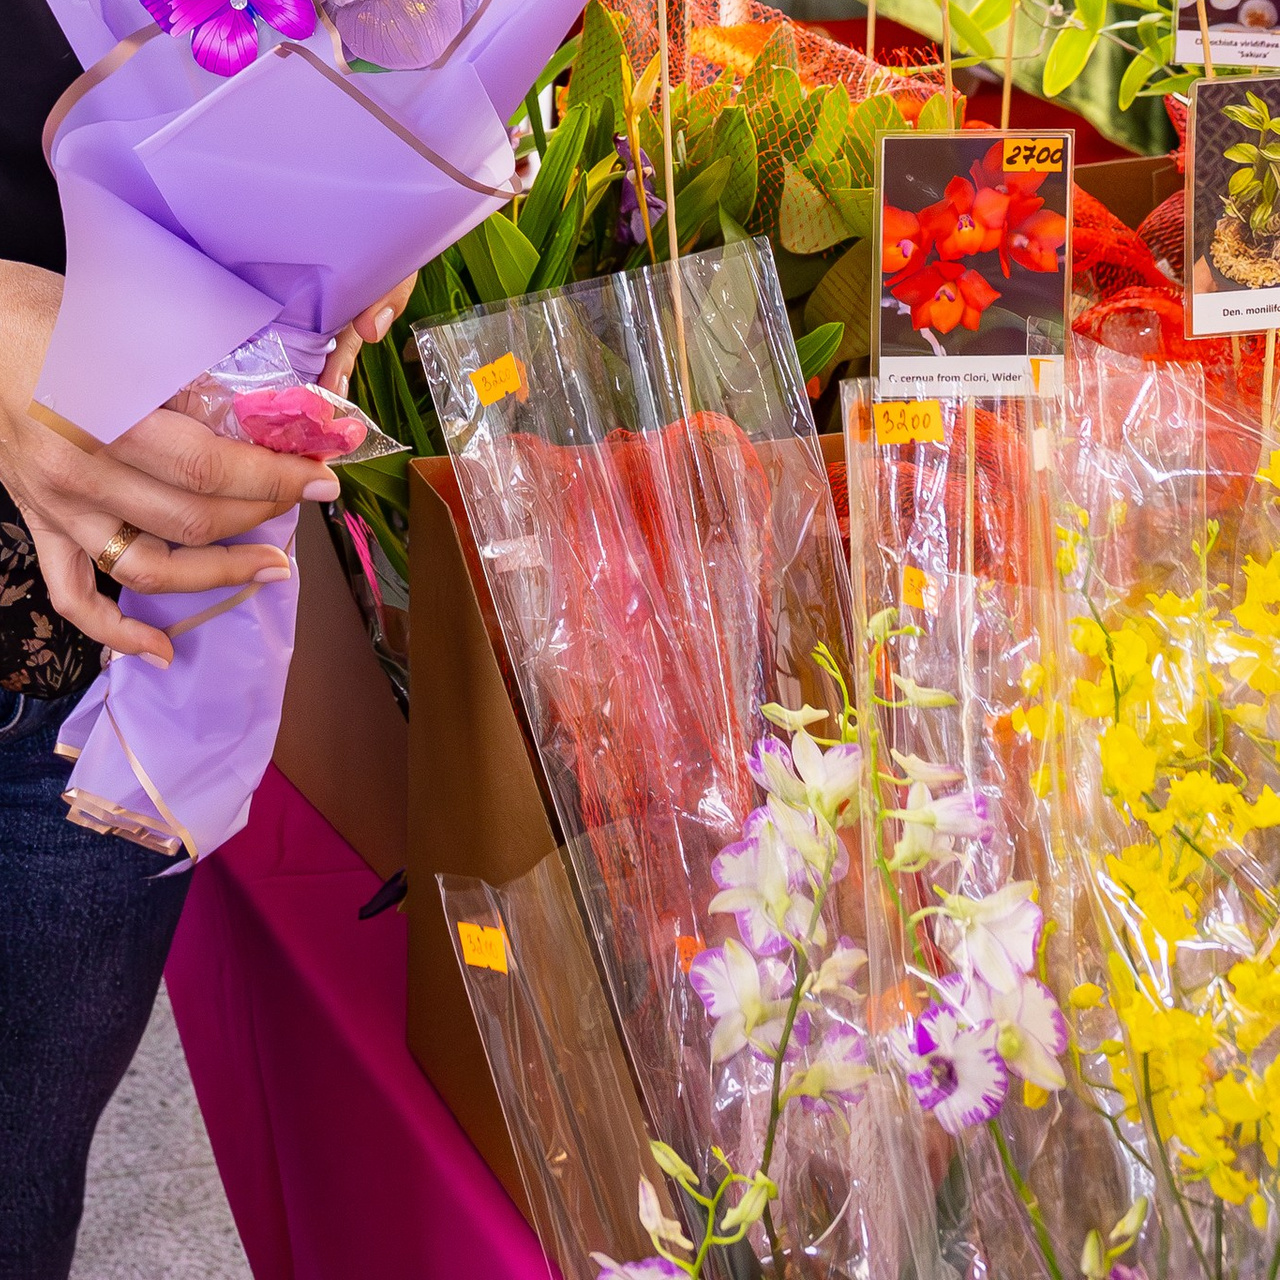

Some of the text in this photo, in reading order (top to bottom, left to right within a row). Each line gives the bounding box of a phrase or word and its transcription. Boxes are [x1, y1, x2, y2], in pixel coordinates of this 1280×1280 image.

[1006, 146, 1063, 165] 2700
[1223, 308, 1243, 317] Den.
[937, 373, 960, 382] from
[964, 373, 989, 382] Clori,
[992, 372, 1023, 382] Wider
[883, 409, 931, 434] 3200
